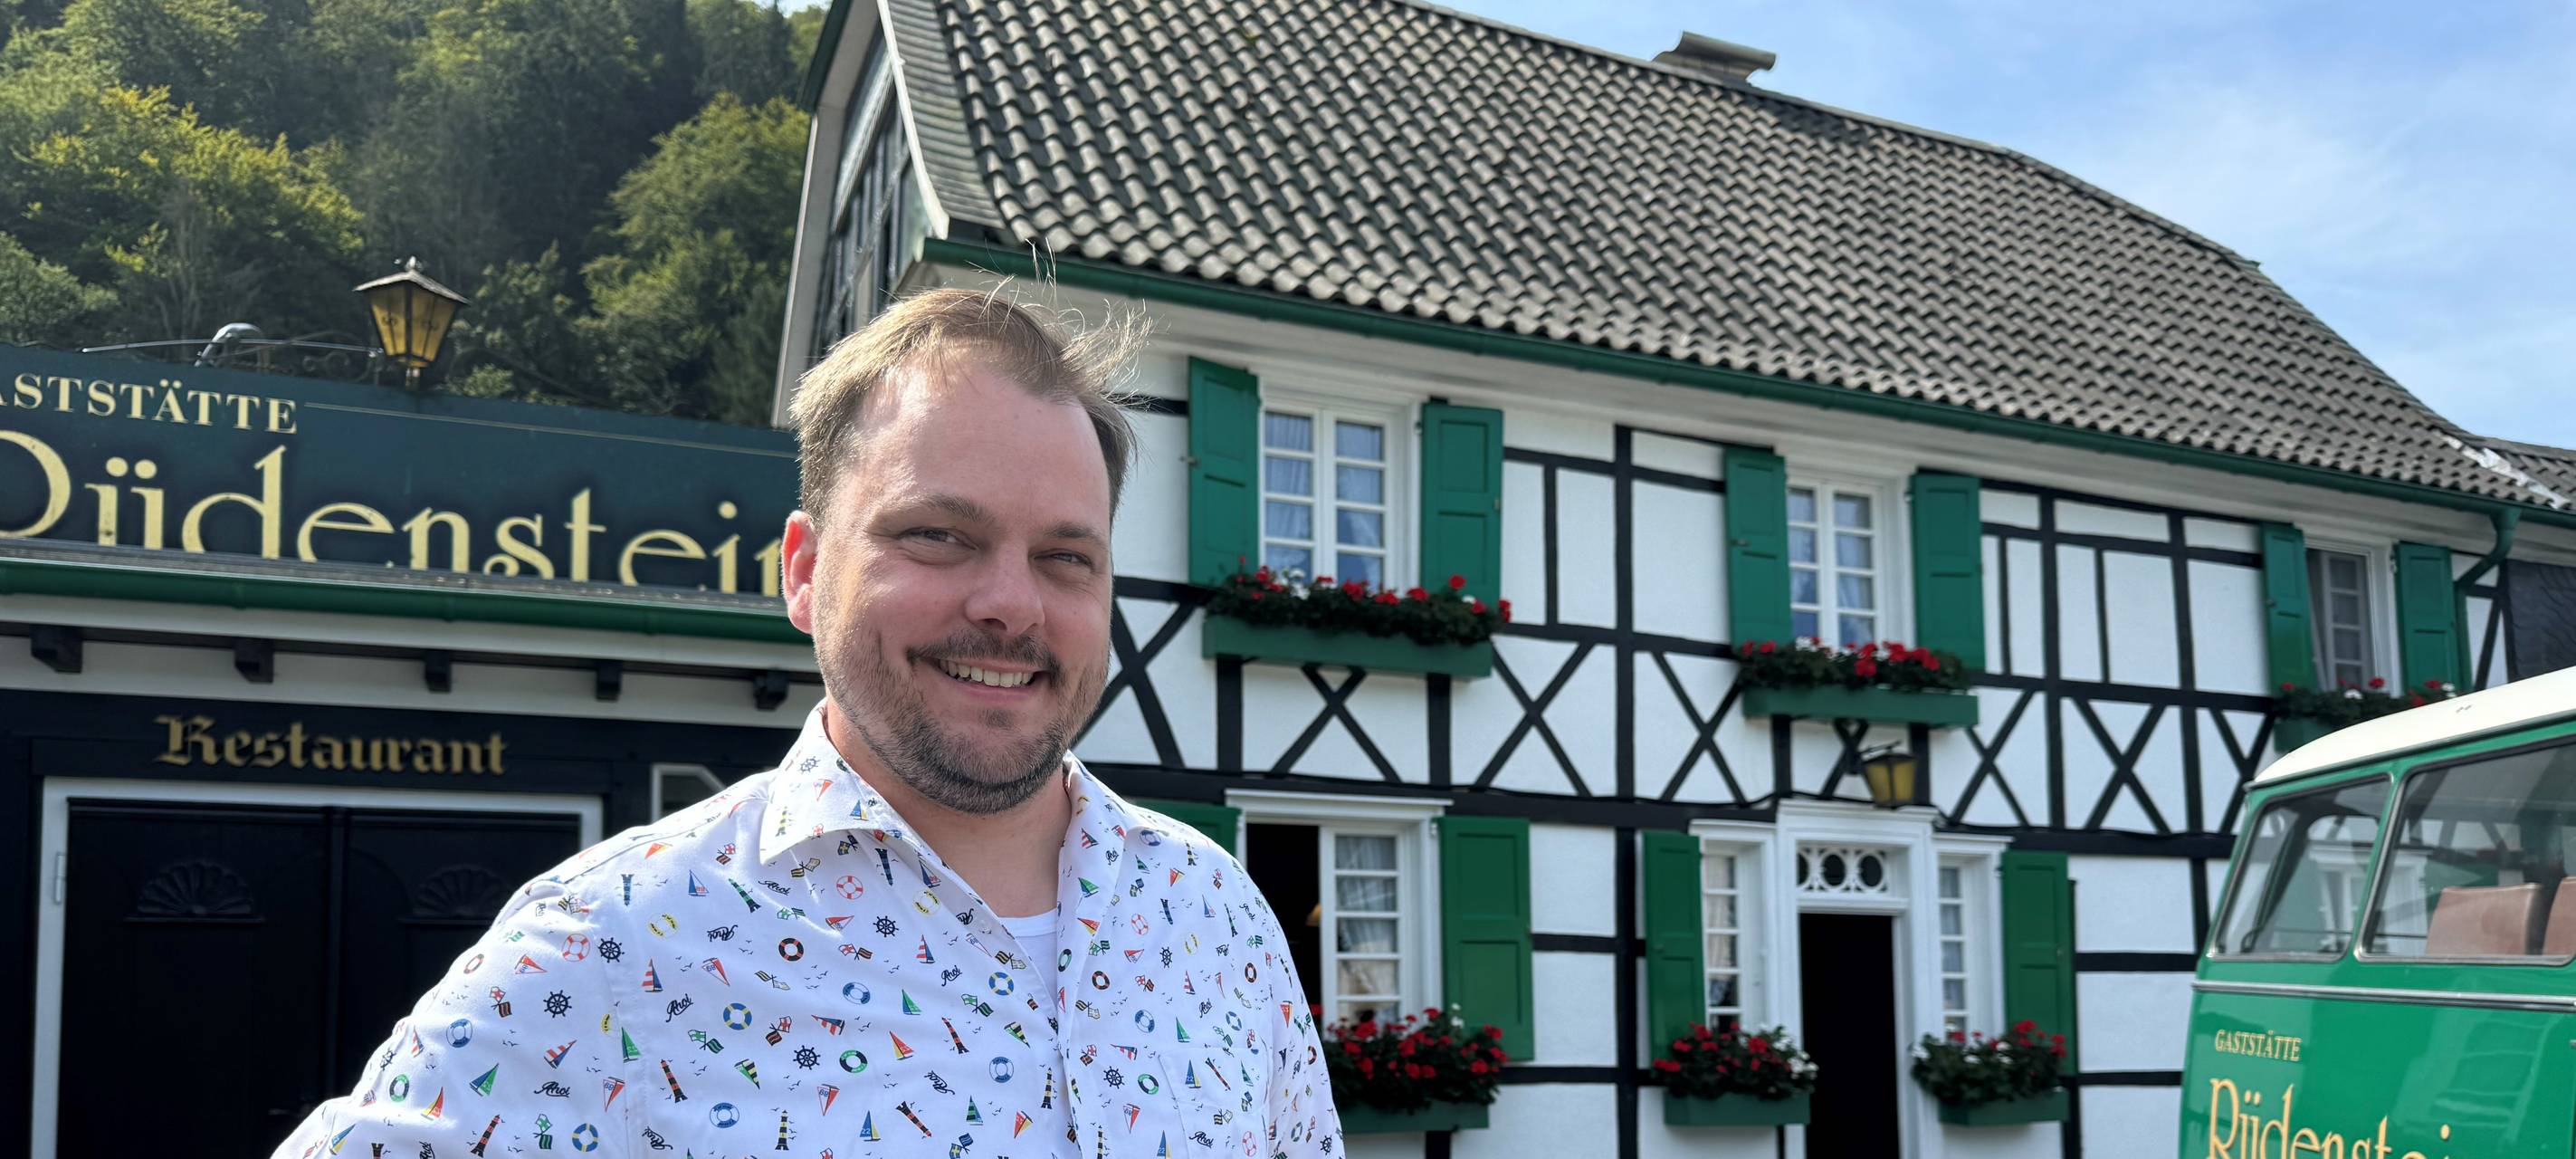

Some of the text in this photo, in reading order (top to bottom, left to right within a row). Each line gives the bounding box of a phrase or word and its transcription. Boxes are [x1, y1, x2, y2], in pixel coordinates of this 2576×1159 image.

[0, 372, 298, 435] STSTÄTTE
[152, 714, 508, 776] Restaurant
[665, 993, 693, 1022] Ahoi
[2214, 1029, 2302, 1062] GASTSTÄTTE
[534, 1081, 570, 1097] Ahoi
[1188, 1131, 1215, 1148] Ahoi
